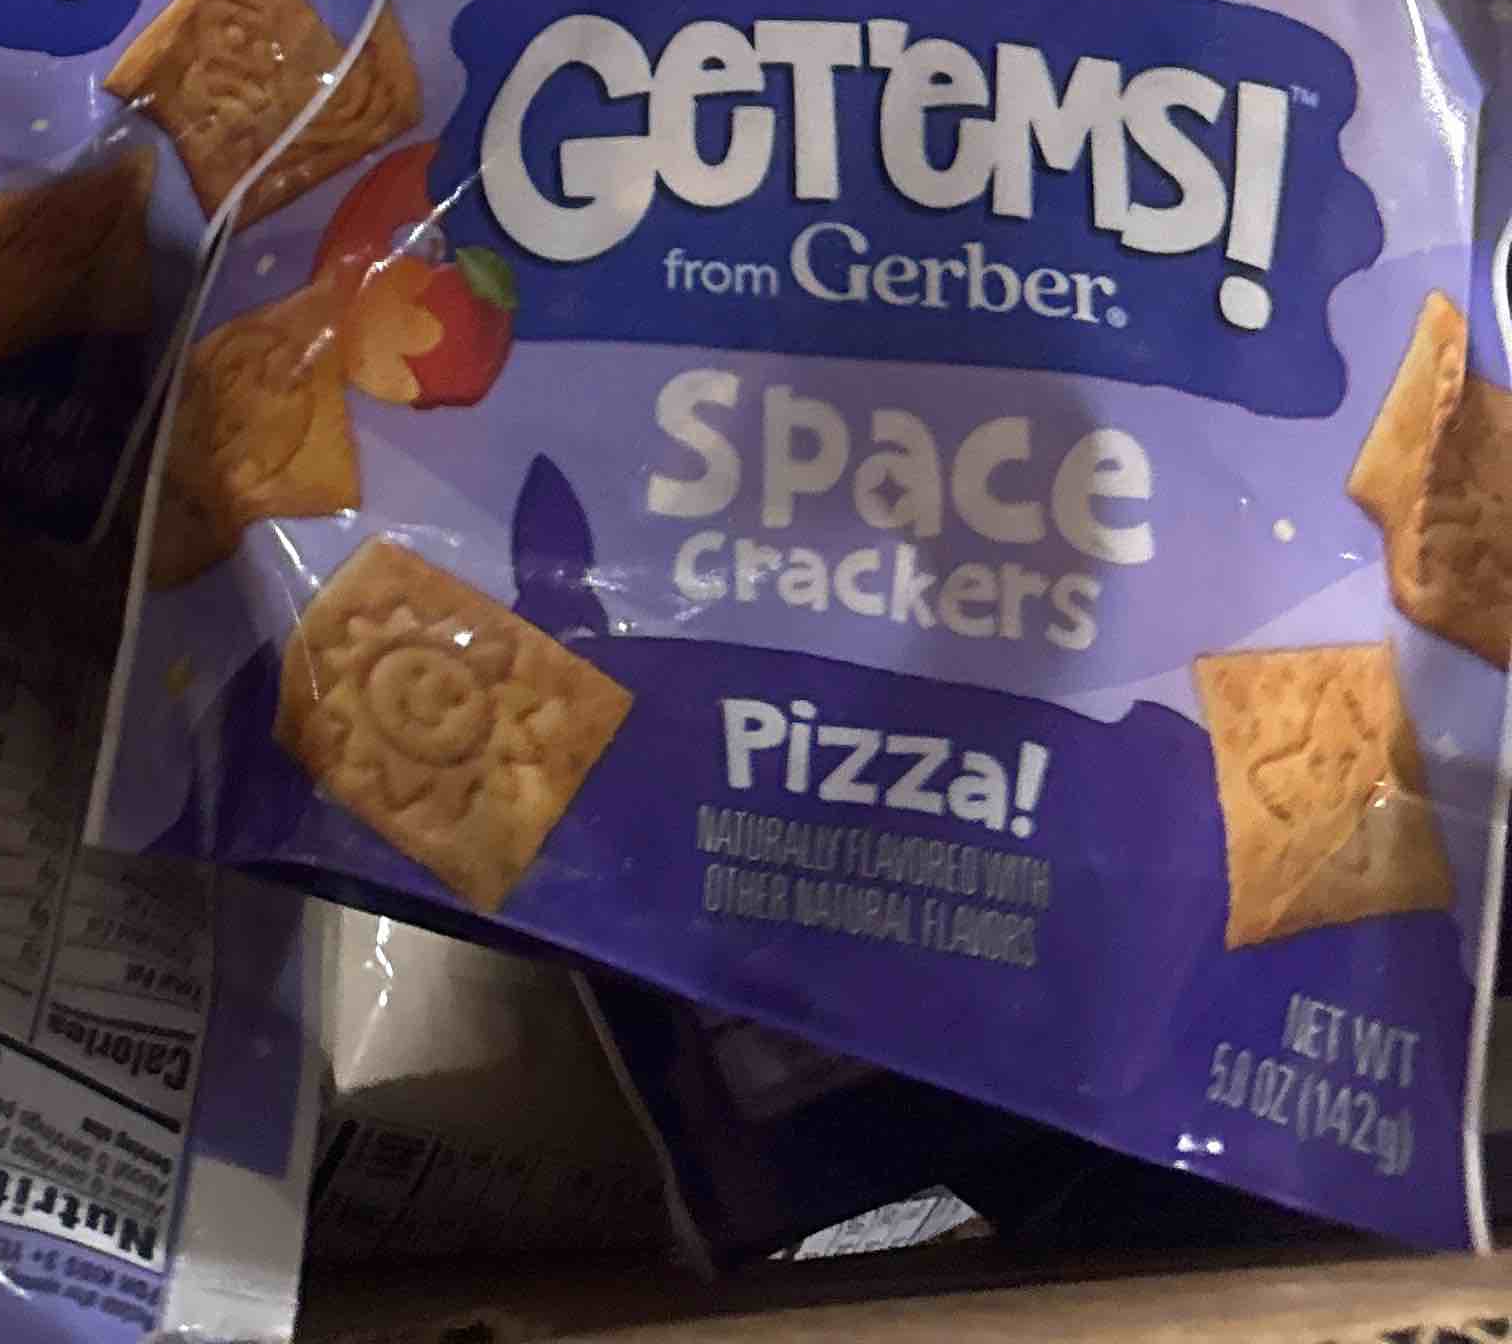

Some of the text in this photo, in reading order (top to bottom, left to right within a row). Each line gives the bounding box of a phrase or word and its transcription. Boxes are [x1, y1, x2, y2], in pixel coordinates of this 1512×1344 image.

[663, 248, 779, 298] from
[646, 368, 1156, 565] Space
[720, 697, 1052, 838] Pizza!
[1283, 993, 1420, 1089] NET WT
[1249, 1057, 1416, 1177] OZ (142g)
